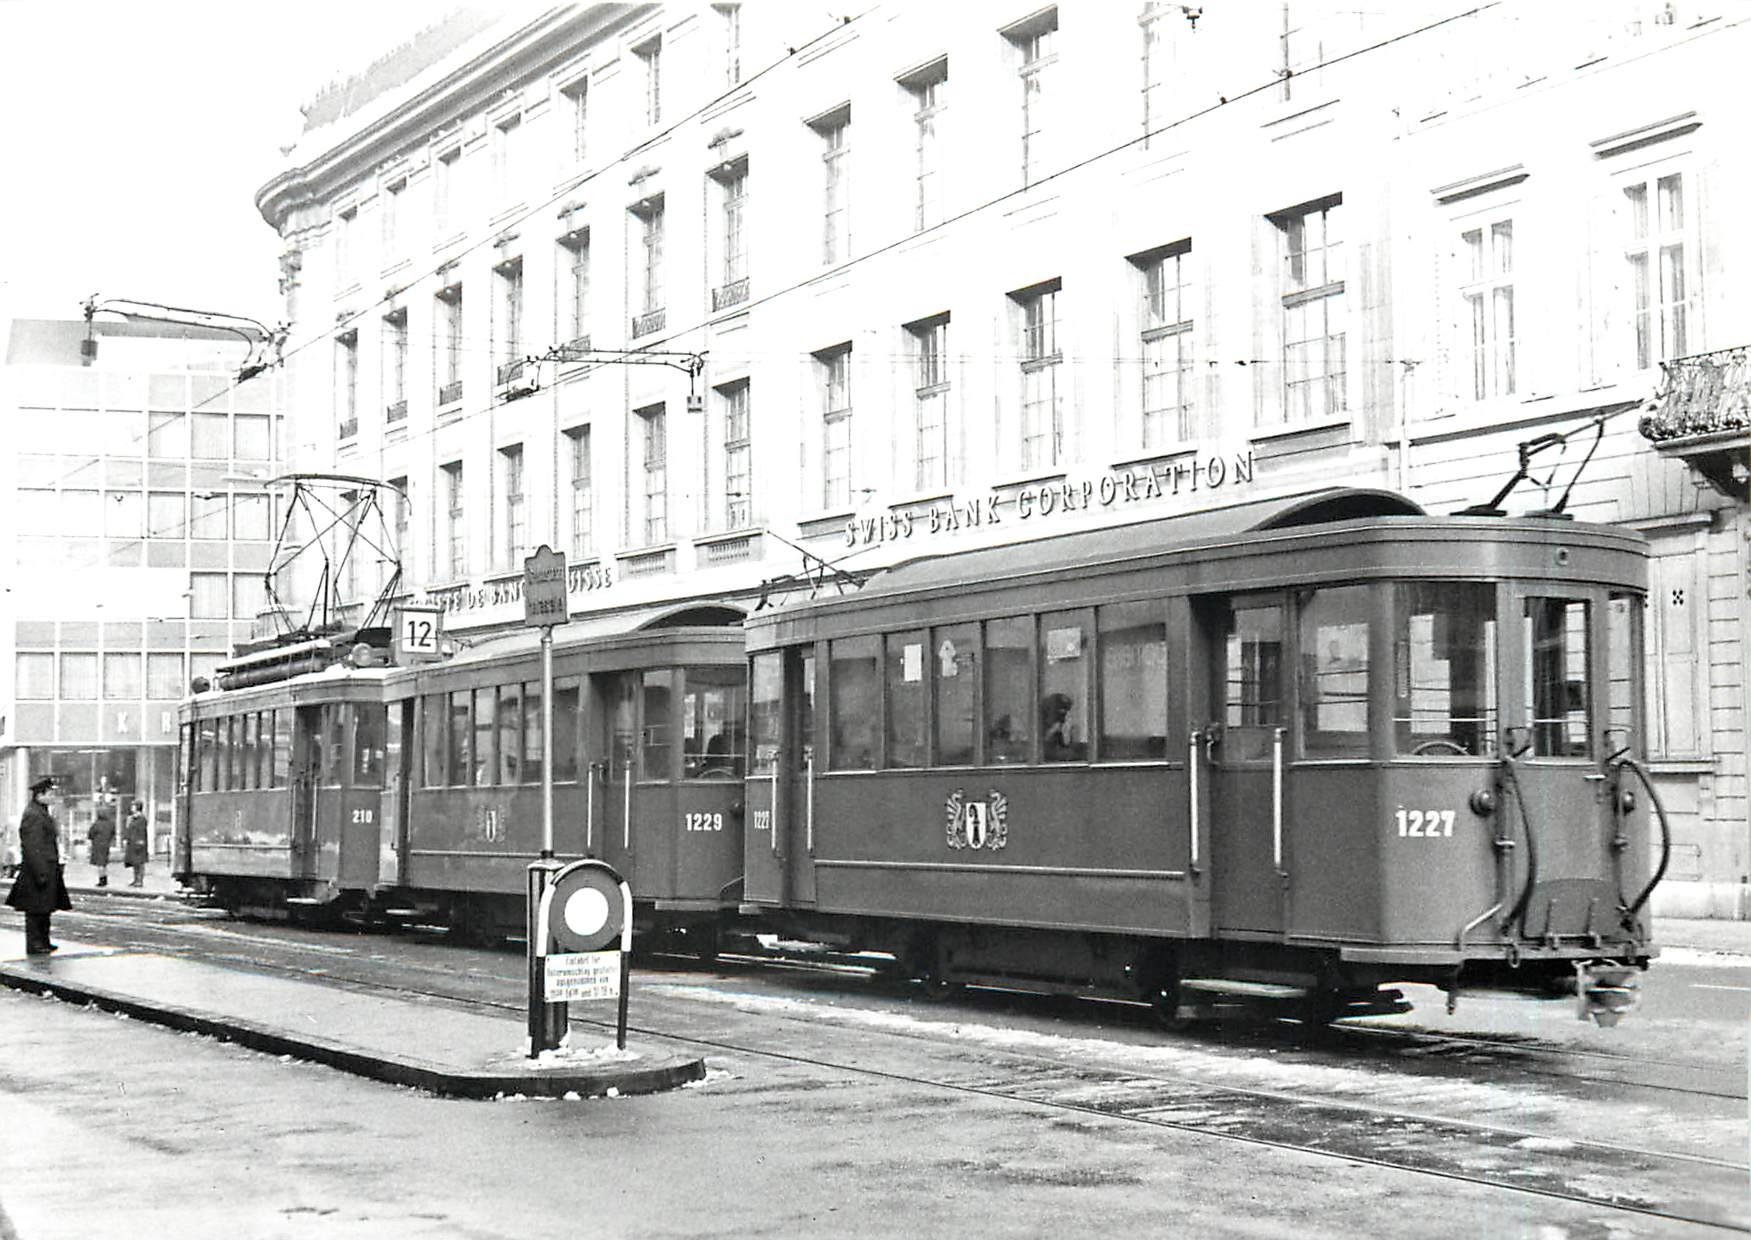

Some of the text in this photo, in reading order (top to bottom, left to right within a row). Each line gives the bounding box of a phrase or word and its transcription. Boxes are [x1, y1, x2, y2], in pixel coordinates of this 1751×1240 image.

[845, 452, 1254, 548] SWISS BANK CORPORATION
[408, 620, 431, 647] 12
[352, 809, 373, 824] 210
[685, 813, 723, 831] 1229
[753, 810, 770, 829] 1227
[1395, 809, 1456, 838] 1227
